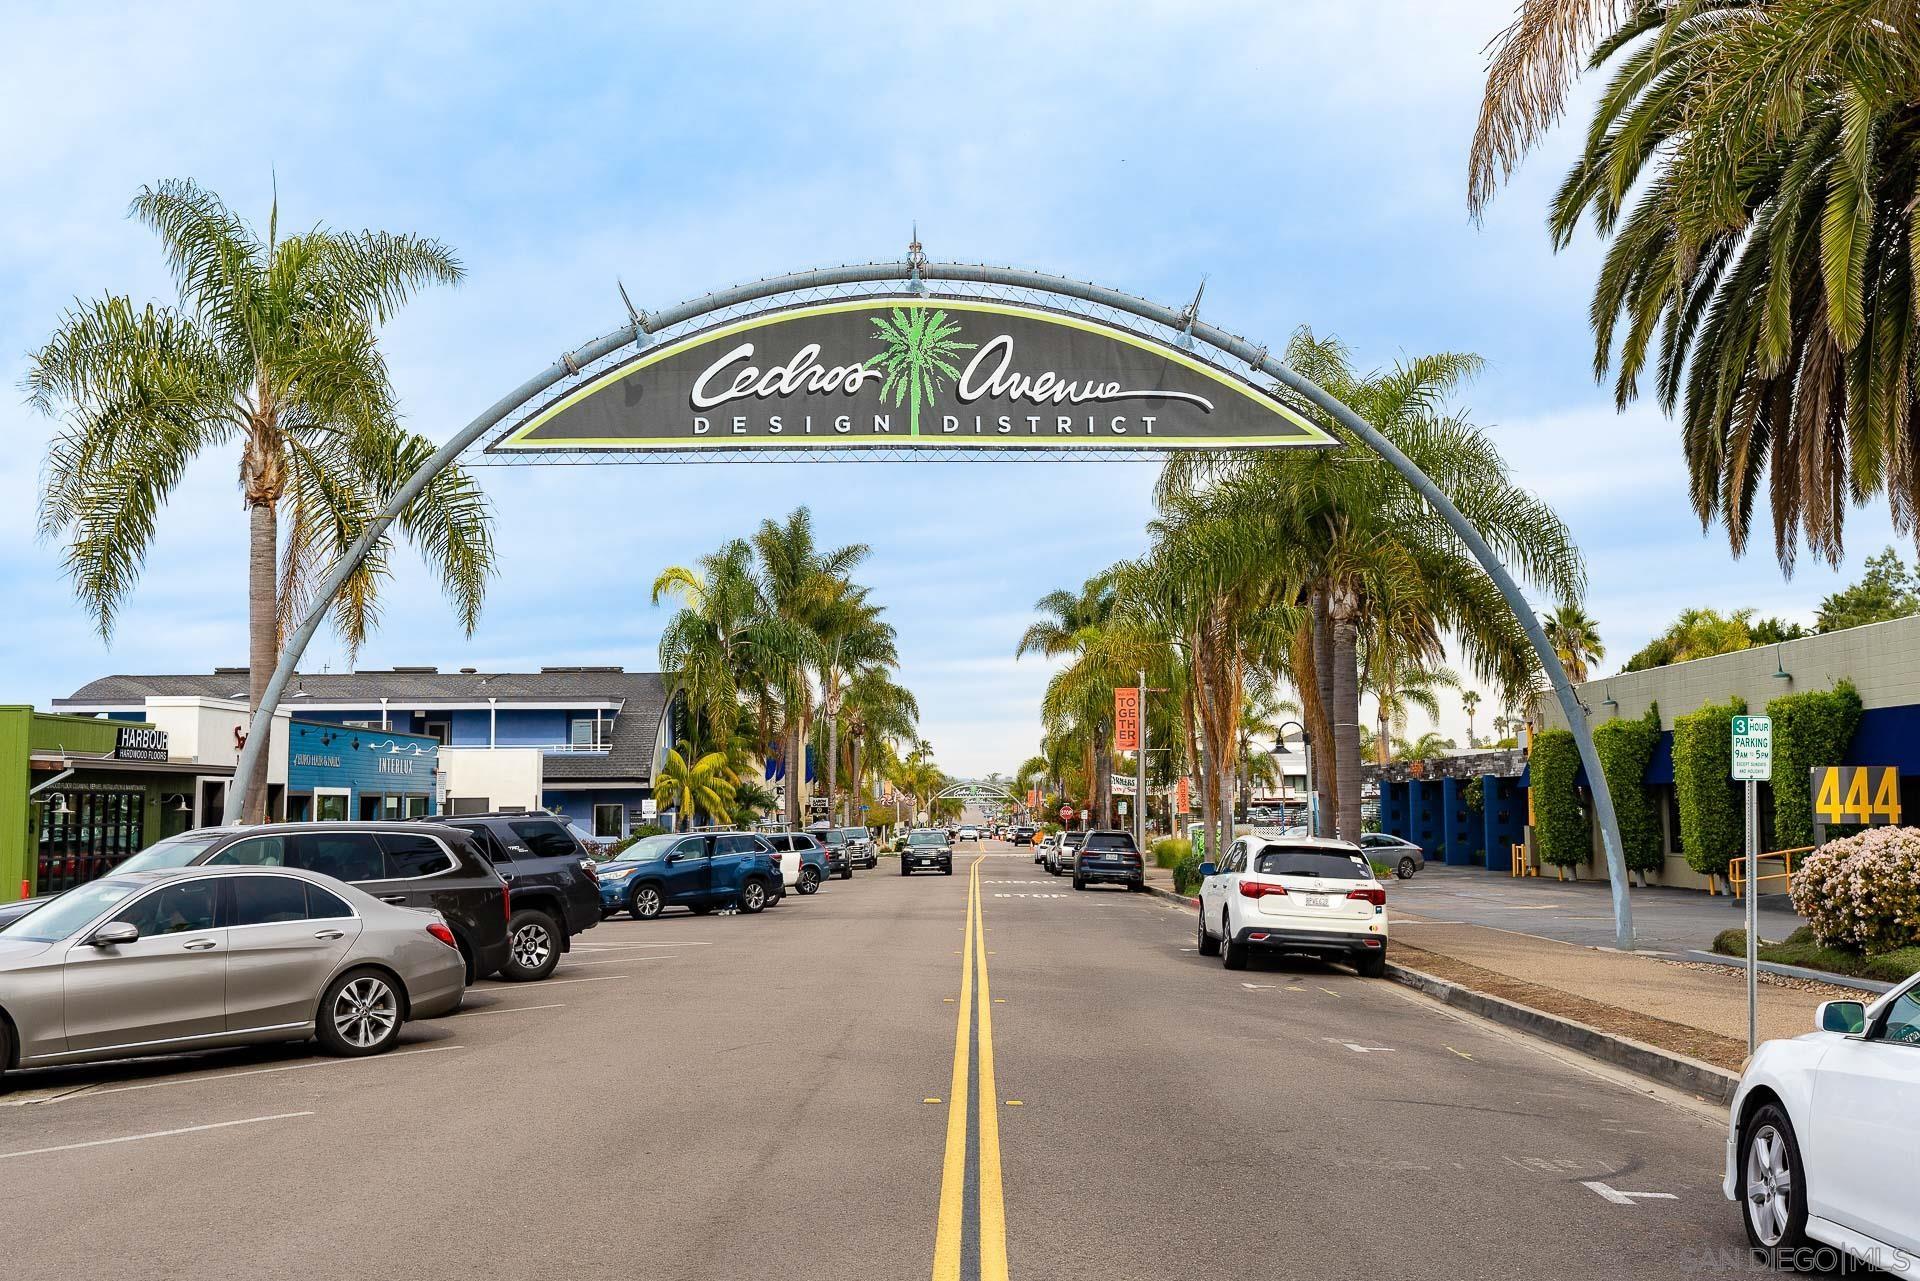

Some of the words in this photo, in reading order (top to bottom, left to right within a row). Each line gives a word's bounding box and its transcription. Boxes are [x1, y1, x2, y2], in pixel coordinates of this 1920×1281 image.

[691, 342, 884, 409] Cedros
[958, 334, 1214, 411] Avenue
[693, 414, 891, 434] DESIGN
[943, 415, 1157, 434] DISTRICT
[1118, 697, 1136, 708] TO
[1118, 708, 1136, 718] GE
[1118, 719, 1136, 729] TH
[1736, 719, 1746, 733] 3
[1749, 722, 1769, 732] HOUR
[121, 727, 169, 750] HARBOUR
[1119, 730, 1136, 740] ER
[1735, 737, 1768, 748] PARKING
[119, 749, 148, 759] HARDWOOD
[148, 750, 167, 761] FLOORS
[378, 757, 413, 775] INTERLUX
[1815, 766, 1902, 824] 444
